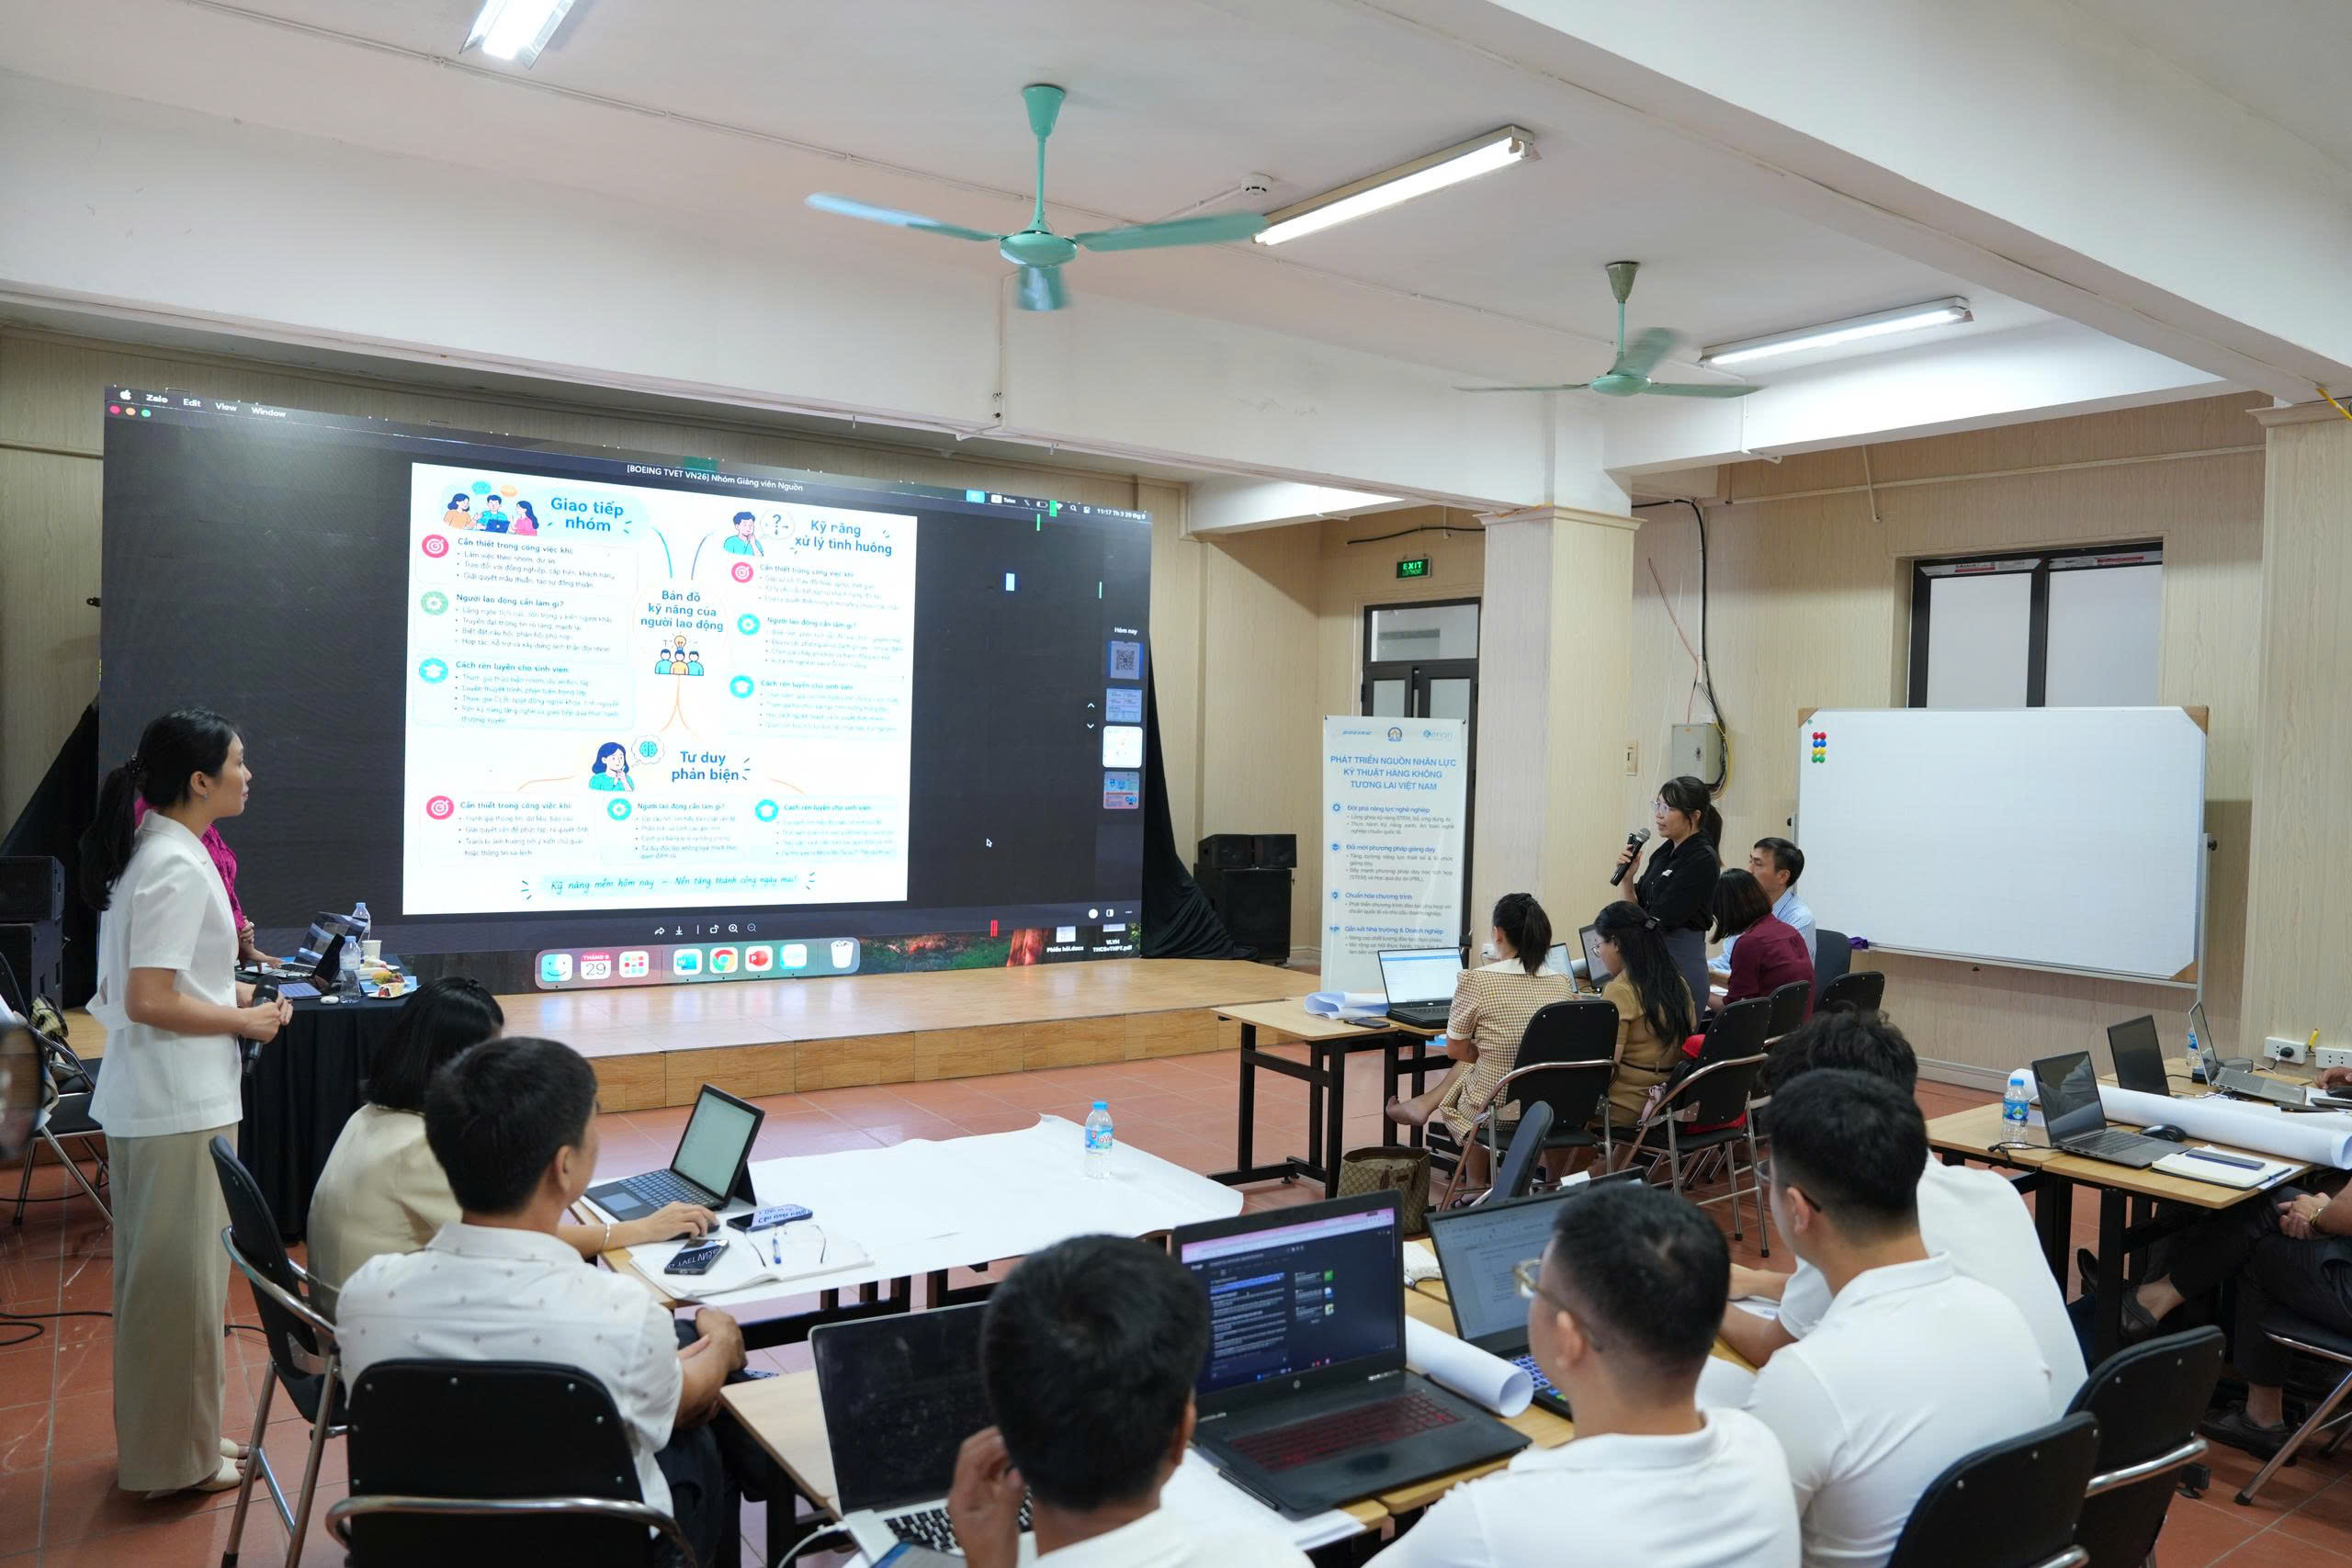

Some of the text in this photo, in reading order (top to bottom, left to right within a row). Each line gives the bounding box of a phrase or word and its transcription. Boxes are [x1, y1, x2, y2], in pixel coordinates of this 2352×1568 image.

[146, 394, 286, 418] Zalo Edit View Window
[627, 464, 662, 475] [BOEING
[685, 471, 710, 481] VN26]
[712, 474, 735, 484] Nhóm
[760, 480, 776, 488] viên
[551, 497, 624, 518] Giao tiếp
[565, 517, 611, 531] nhóm
[811, 520, 827, 535] Kỹ
[497, 541, 518, 551] trong
[795, 535, 810, 546] xử
[814, 536, 824, 550] lý
[828, 538, 851, 550] tình
[1403, 561, 1422, 570] EXIT
[662, 590, 701, 602] Bản đồ
[648, 602, 717, 617] kỹ năng của
[641, 616, 723, 632] người lao động
[680, 750, 726, 766] Tư duy
[1331, 755, 1352, 764] PHÁT
[1413, 757, 1436, 766] NHÂN
[672, 768, 738, 783] phản biện
[551, 880, 562, 894] Kỹ
[568, 881, 590, 894] năng
[639, 881, 654, 889] nay
[586, 962, 606, 975] 29
